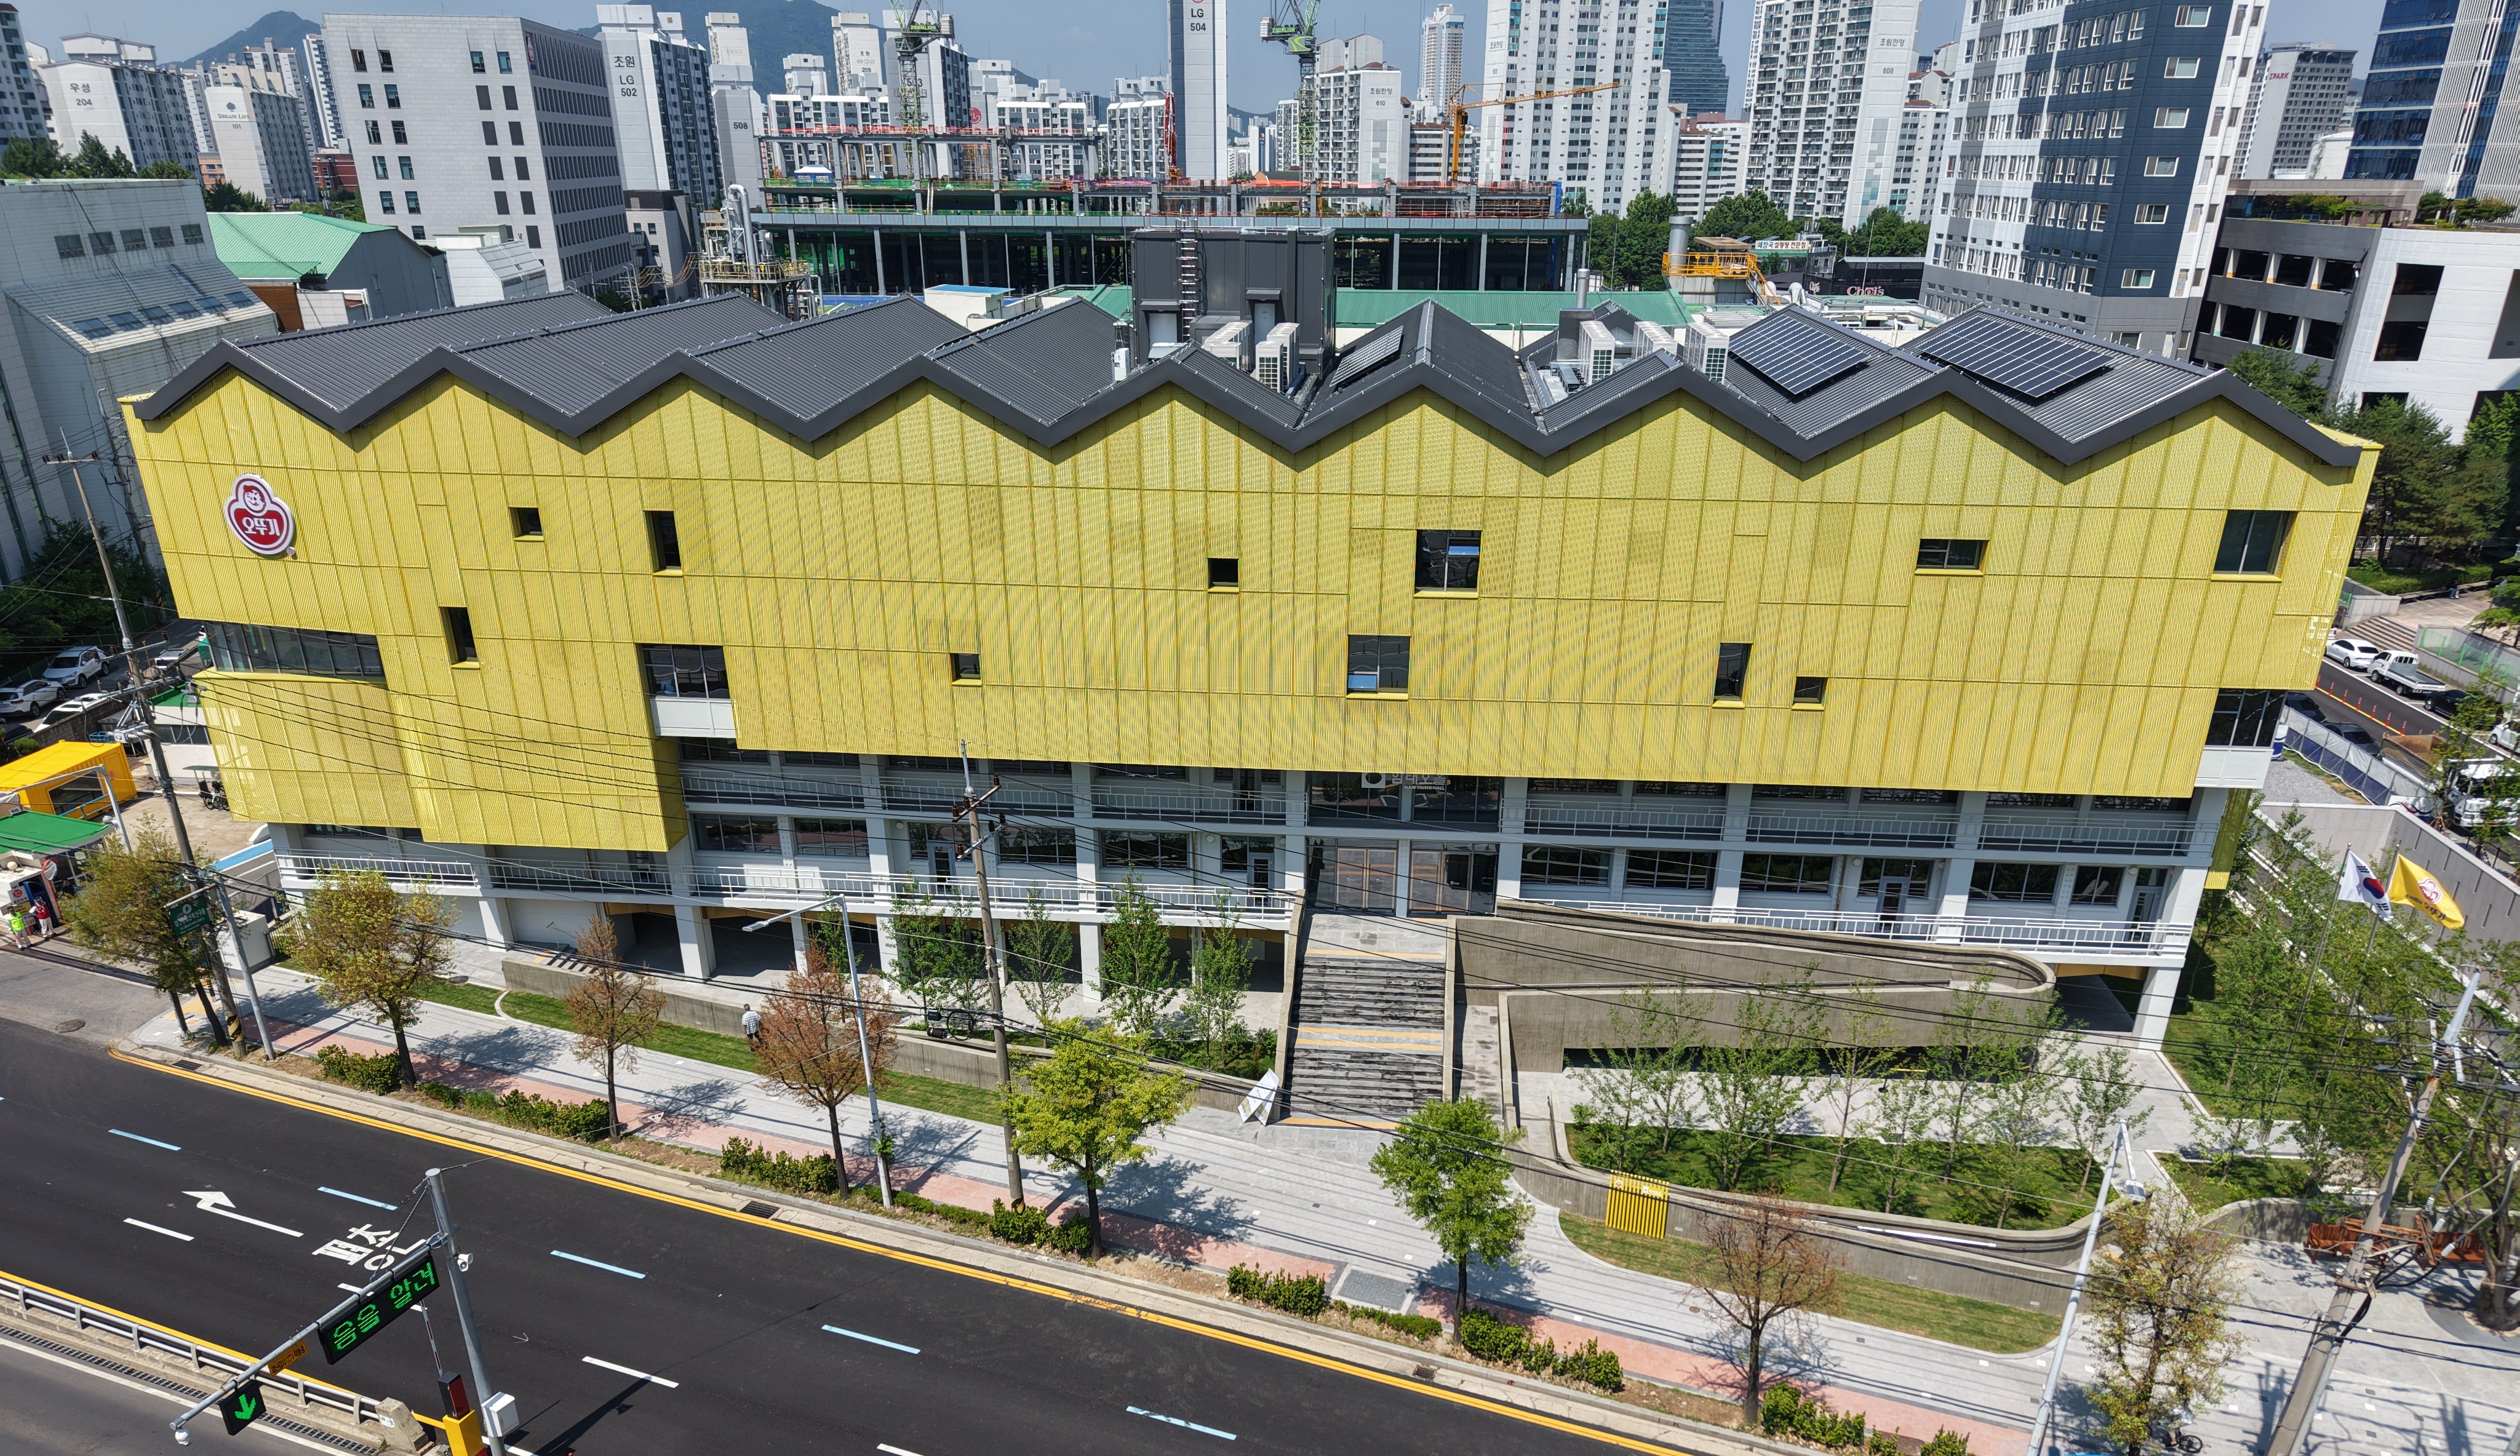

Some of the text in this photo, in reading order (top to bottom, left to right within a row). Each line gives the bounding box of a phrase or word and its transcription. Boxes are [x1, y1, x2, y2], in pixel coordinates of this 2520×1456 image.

[1190, 8, 1204, 18] LG
[1190, 22, 1206, 31] 504
[613, 55, 635, 68] 초원
[620, 74, 634, 85] LG
[70, 82, 91, 93] 우성
[621, 87, 637, 97] 502
[242, 517, 281, 536] 오뚜기
[333, 1262, 435, 1350] 음을 알려
